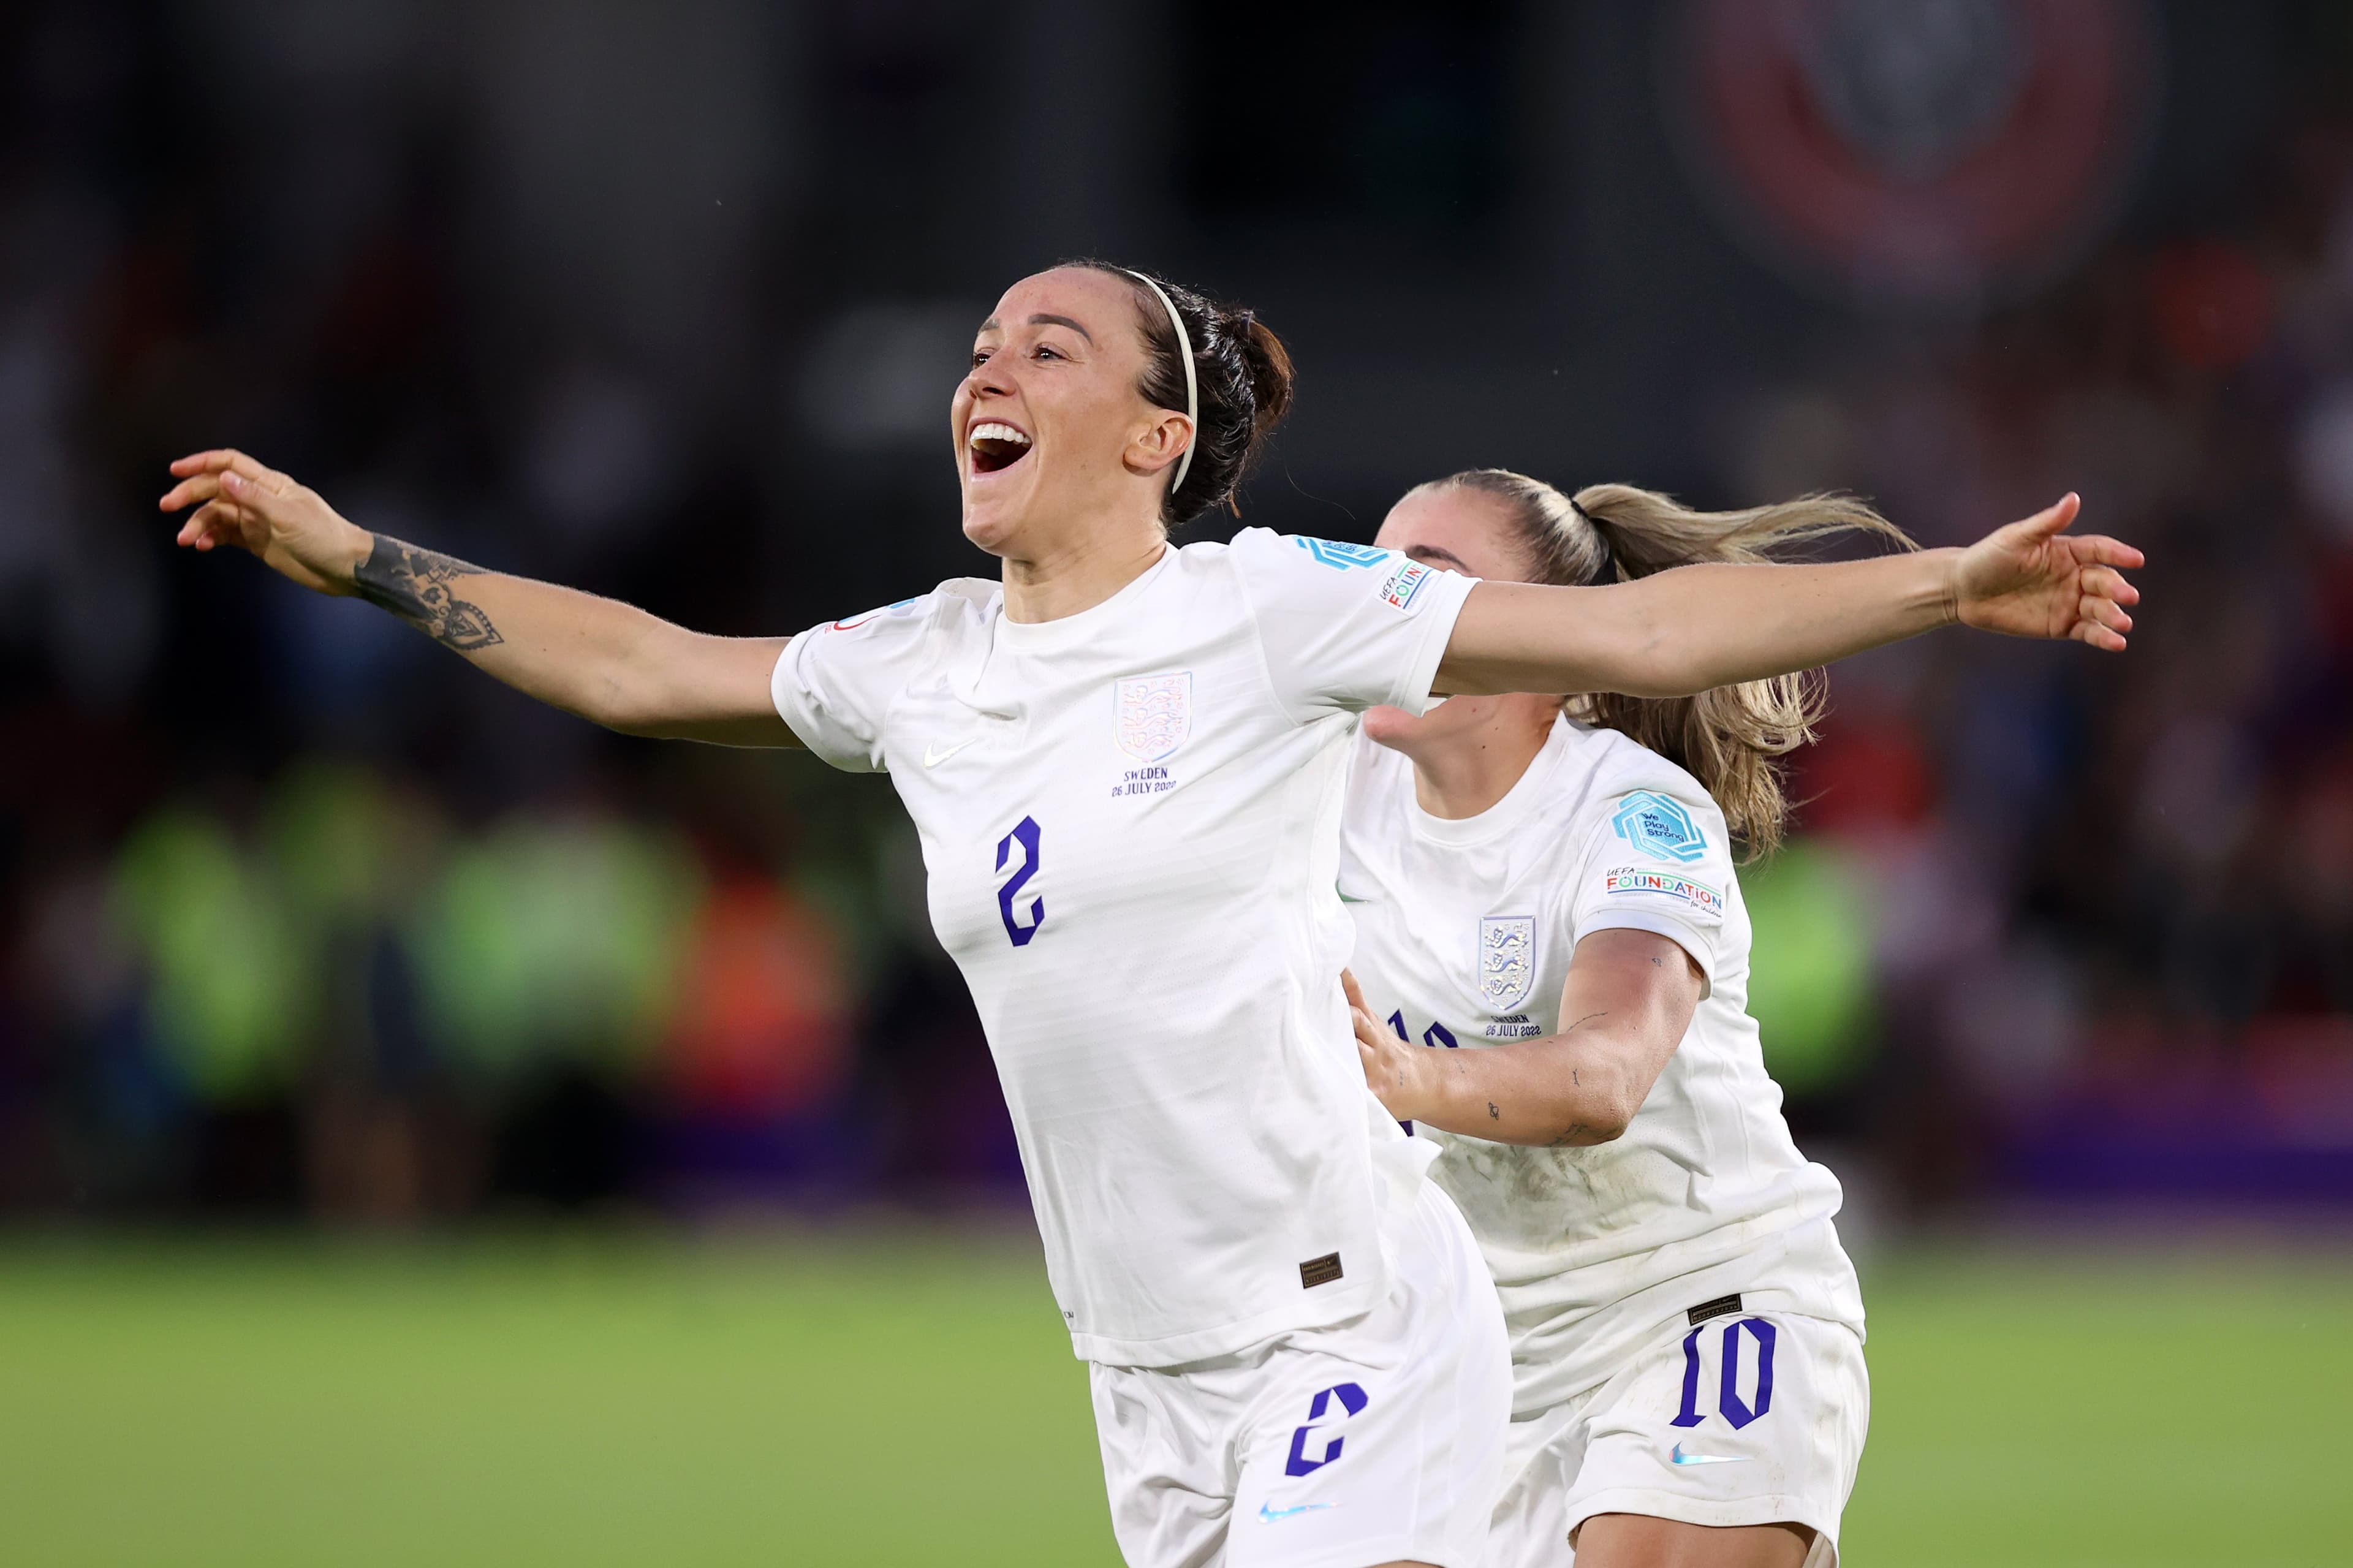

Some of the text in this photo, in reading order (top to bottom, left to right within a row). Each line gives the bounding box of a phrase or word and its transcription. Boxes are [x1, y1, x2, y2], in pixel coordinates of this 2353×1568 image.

[1379, 577, 1397, 600] UEFA
[1124, 767, 1168, 782] SWEDEN
[1112, 781, 1176, 797] 26 JULY 2022
[1647, 828, 1684, 843] Strong
[1607, 866, 1635, 877] UEFA
[995, 815, 1045, 947] 2
[1607, 876, 1721, 910] FOUNDATION
[1490, 1014, 1530, 1023] SWEDEN
[1486, 1025, 1542, 1037] 26 JULY 2022
[1669, 1317, 1776, 1430] 10
[1285, 1382, 1369, 1477] 2
